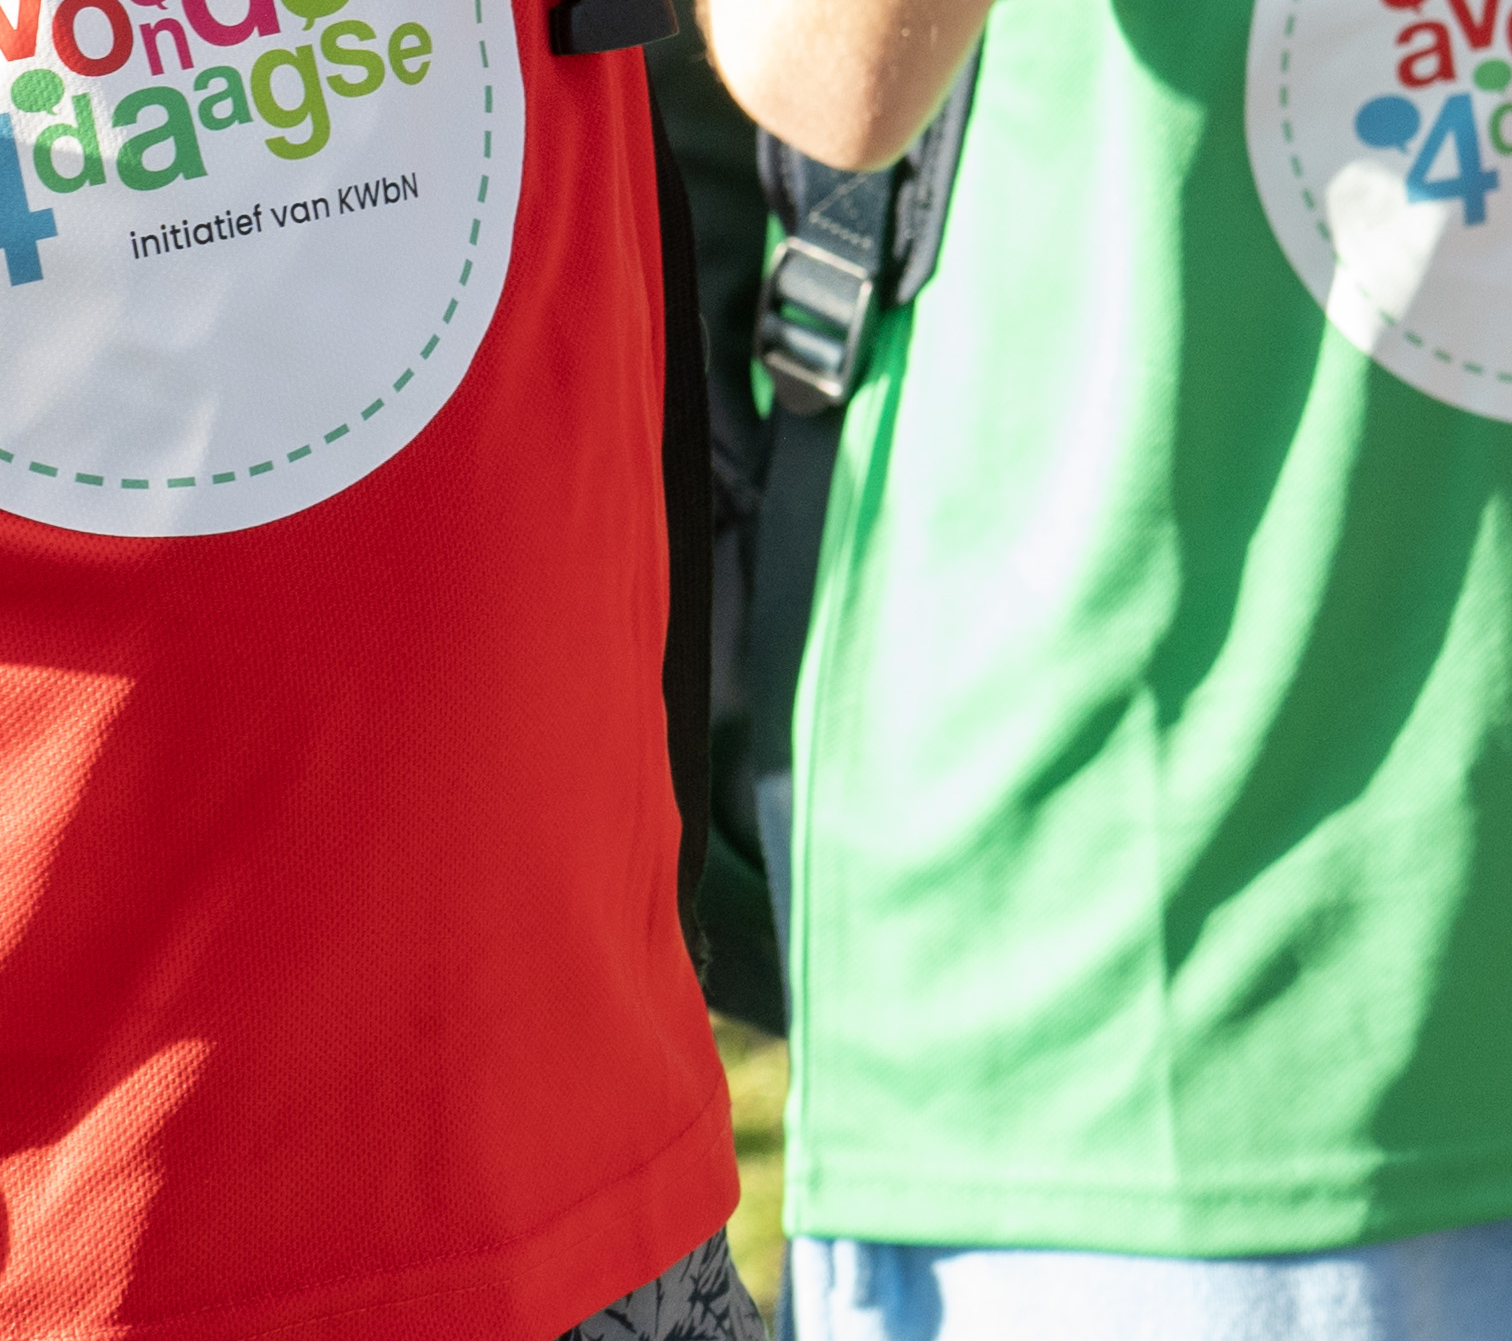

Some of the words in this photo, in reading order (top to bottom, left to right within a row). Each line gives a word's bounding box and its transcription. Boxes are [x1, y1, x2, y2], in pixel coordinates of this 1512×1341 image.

[130, 203, 262, 259] initiatief
[270, 196, 330, 228] van
[338, 172, 419, 214] KWbN
